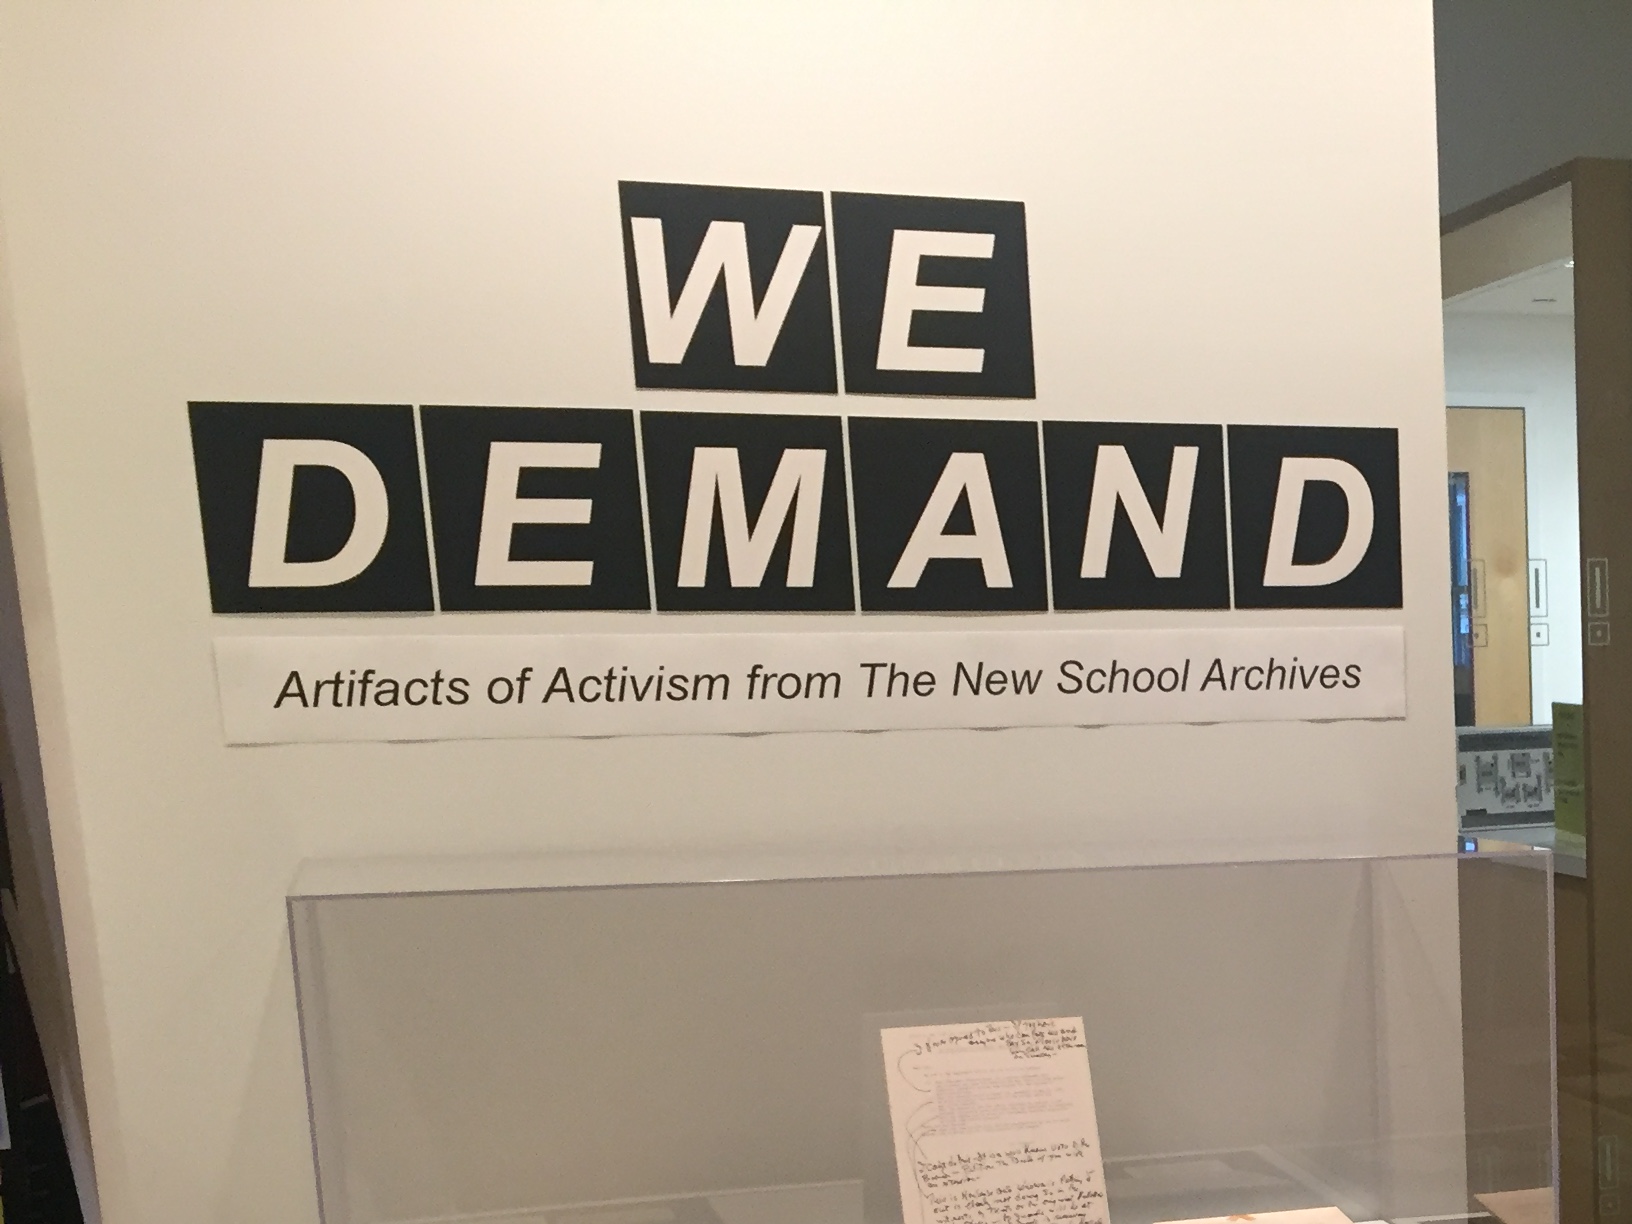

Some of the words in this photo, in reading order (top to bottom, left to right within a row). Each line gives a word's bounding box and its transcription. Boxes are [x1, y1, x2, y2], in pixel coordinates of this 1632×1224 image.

[631, 217, 996, 373] WE
[249, 439, 1375, 588] DEMAND
[273, 667, 470, 708] Artifacts
[487, 666, 534, 705] of
[541, 665, 730, 704] Activism
[746, 664, 841, 700] from
[859, 662, 936, 698] The
[952, 661, 1043, 697] New
[1056, 658, 1191, 695] School
[1199, 656, 1362, 692] Archives
